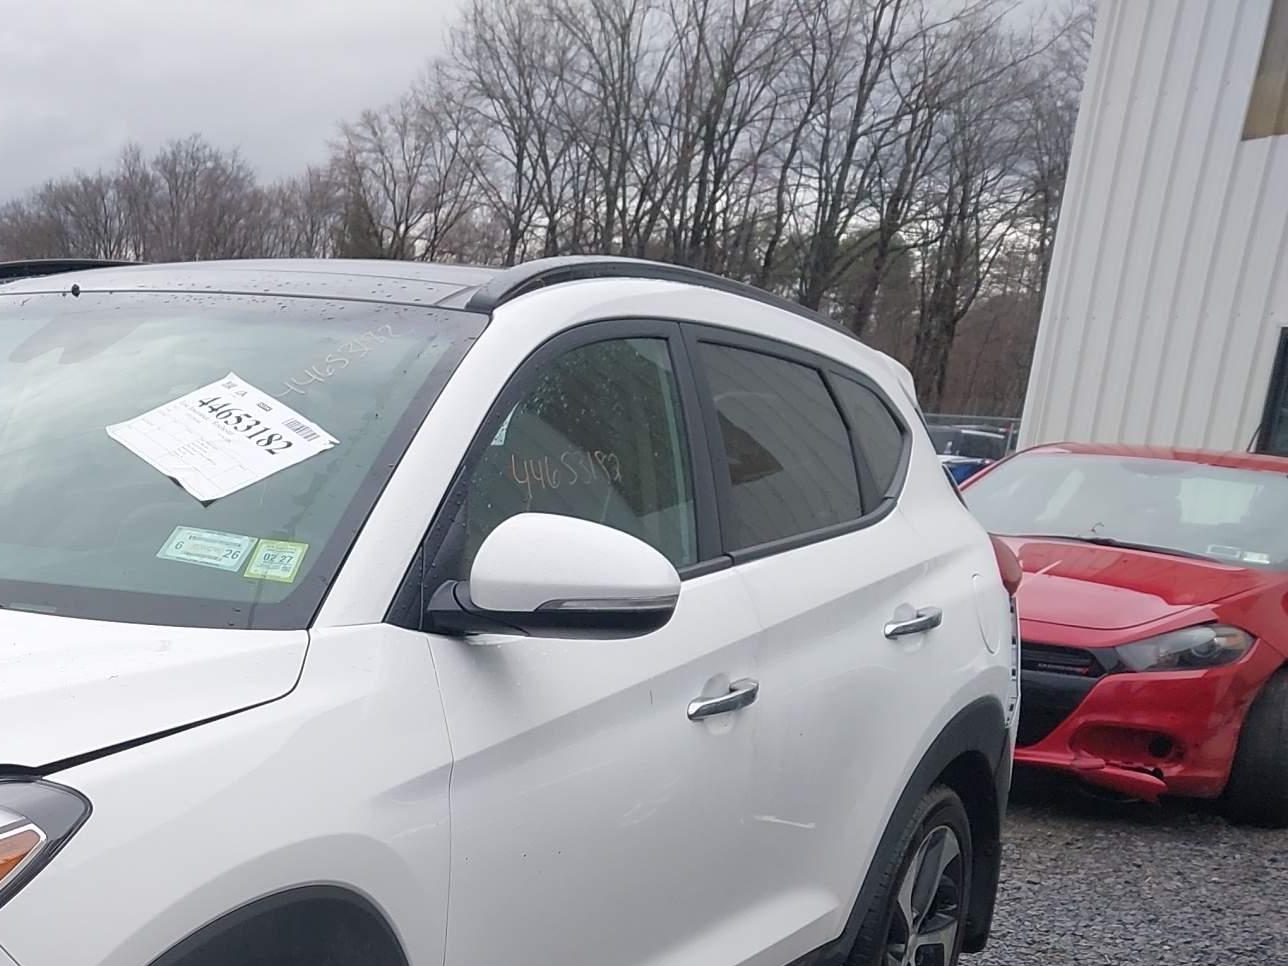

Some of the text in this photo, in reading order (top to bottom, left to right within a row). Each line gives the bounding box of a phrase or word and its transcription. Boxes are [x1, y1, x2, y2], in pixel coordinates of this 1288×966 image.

[198, 396, 294, 455] 44653182
[175, 540, 185, 550] 6
[222, 549, 241, 560] 26
